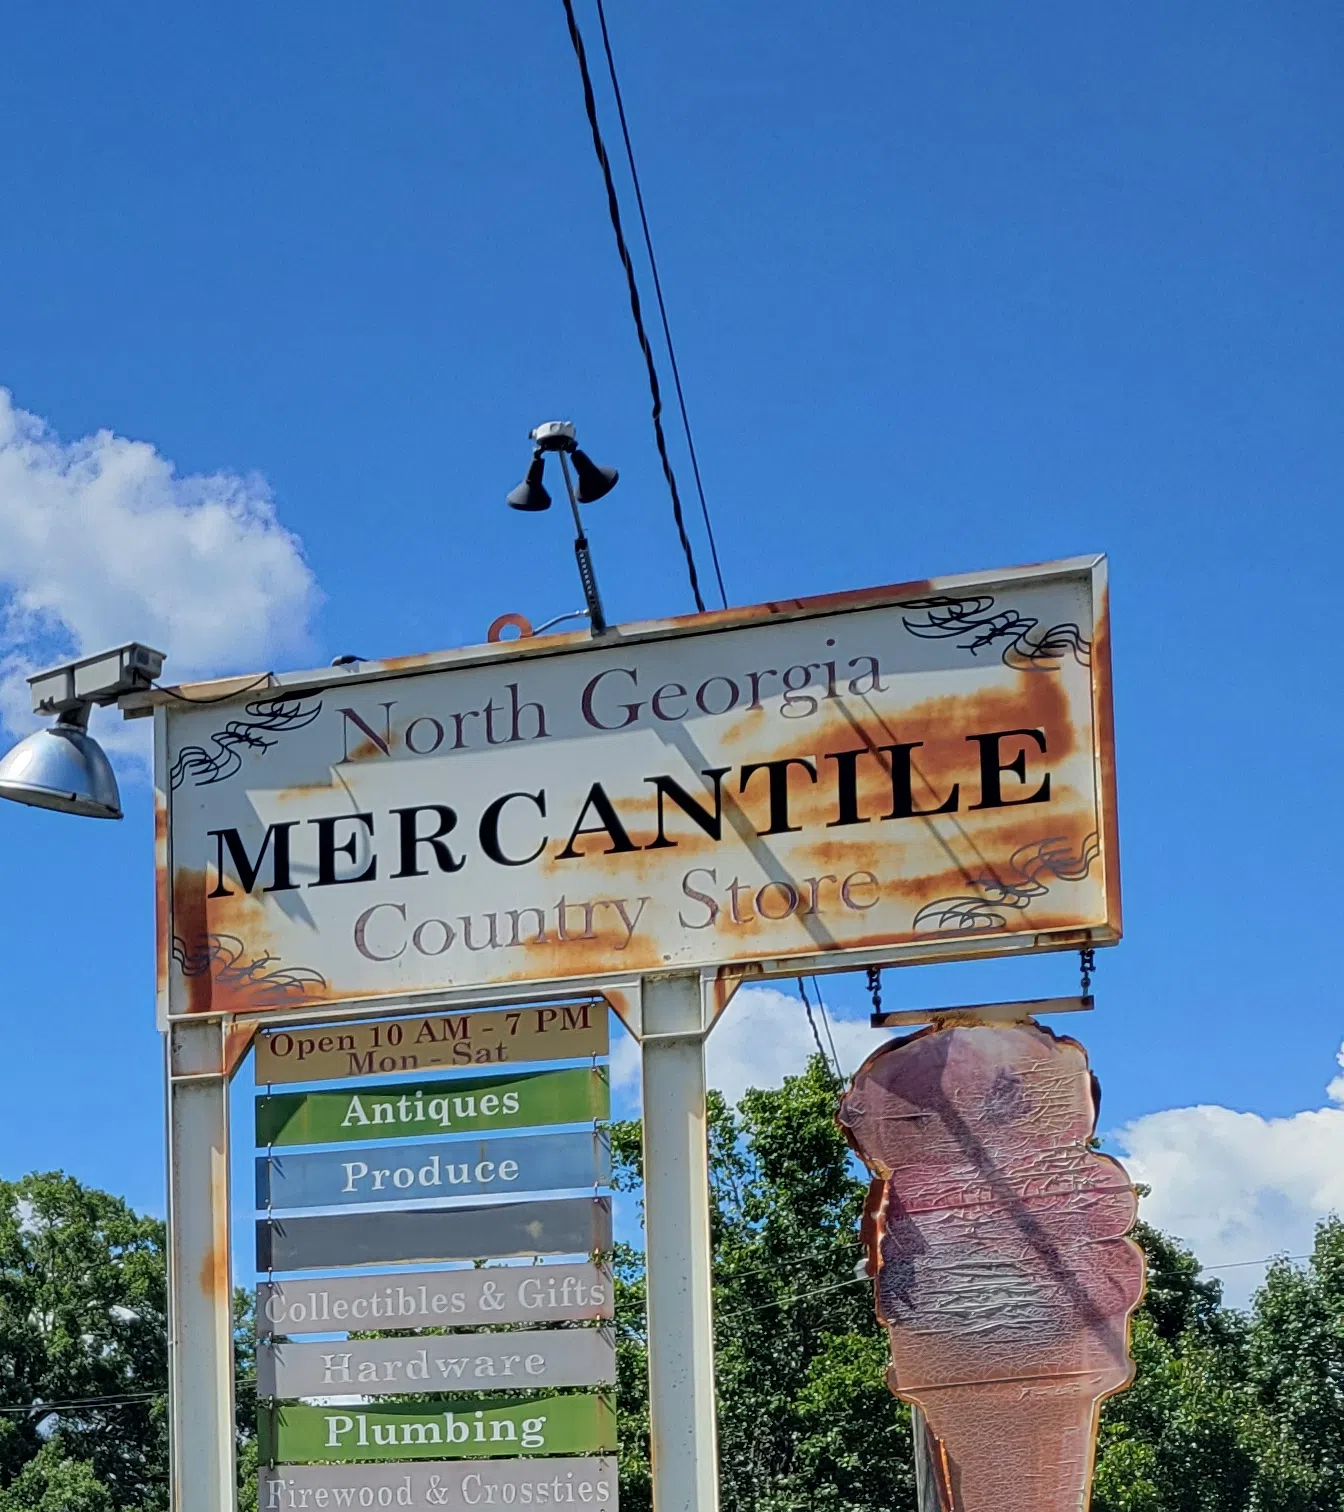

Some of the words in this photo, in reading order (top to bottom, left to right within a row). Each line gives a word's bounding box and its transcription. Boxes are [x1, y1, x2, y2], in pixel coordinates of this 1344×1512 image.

[334, 682, 553, 765] North
[580, 638, 889, 731] Georgia
[206, 726, 1051, 899] MERCANTILE
[353, 893, 652, 963] Country
[678, 867, 882, 930] Store
[269, 1031, 356, 1061] Open
[370, 1022, 404, 1049] 10
[414, 1015, 472, 1045] AM
[505, 1012, 522, 1037] 7
[534, 1004, 594, 1034] PM
[347, 1051, 419, 1077] Mon
[451, 1038, 509, 1066] Sat
[340, 1090, 521, 1128] Antiques
[341, 1156, 520, 1193] Produce
[265, 1285, 466, 1324] Collectibles
[478, 1280, 506, 1313] &
[518, 1275, 606, 1309] Gifts
[320, 1349, 547, 1384] Hardware
[324, 1410, 548, 1449] Plumbing
[265, 1475, 413, 1509] Firewood
[425, 1475, 449, 1505] &
[461, 1471, 611, 1503] Crossties
